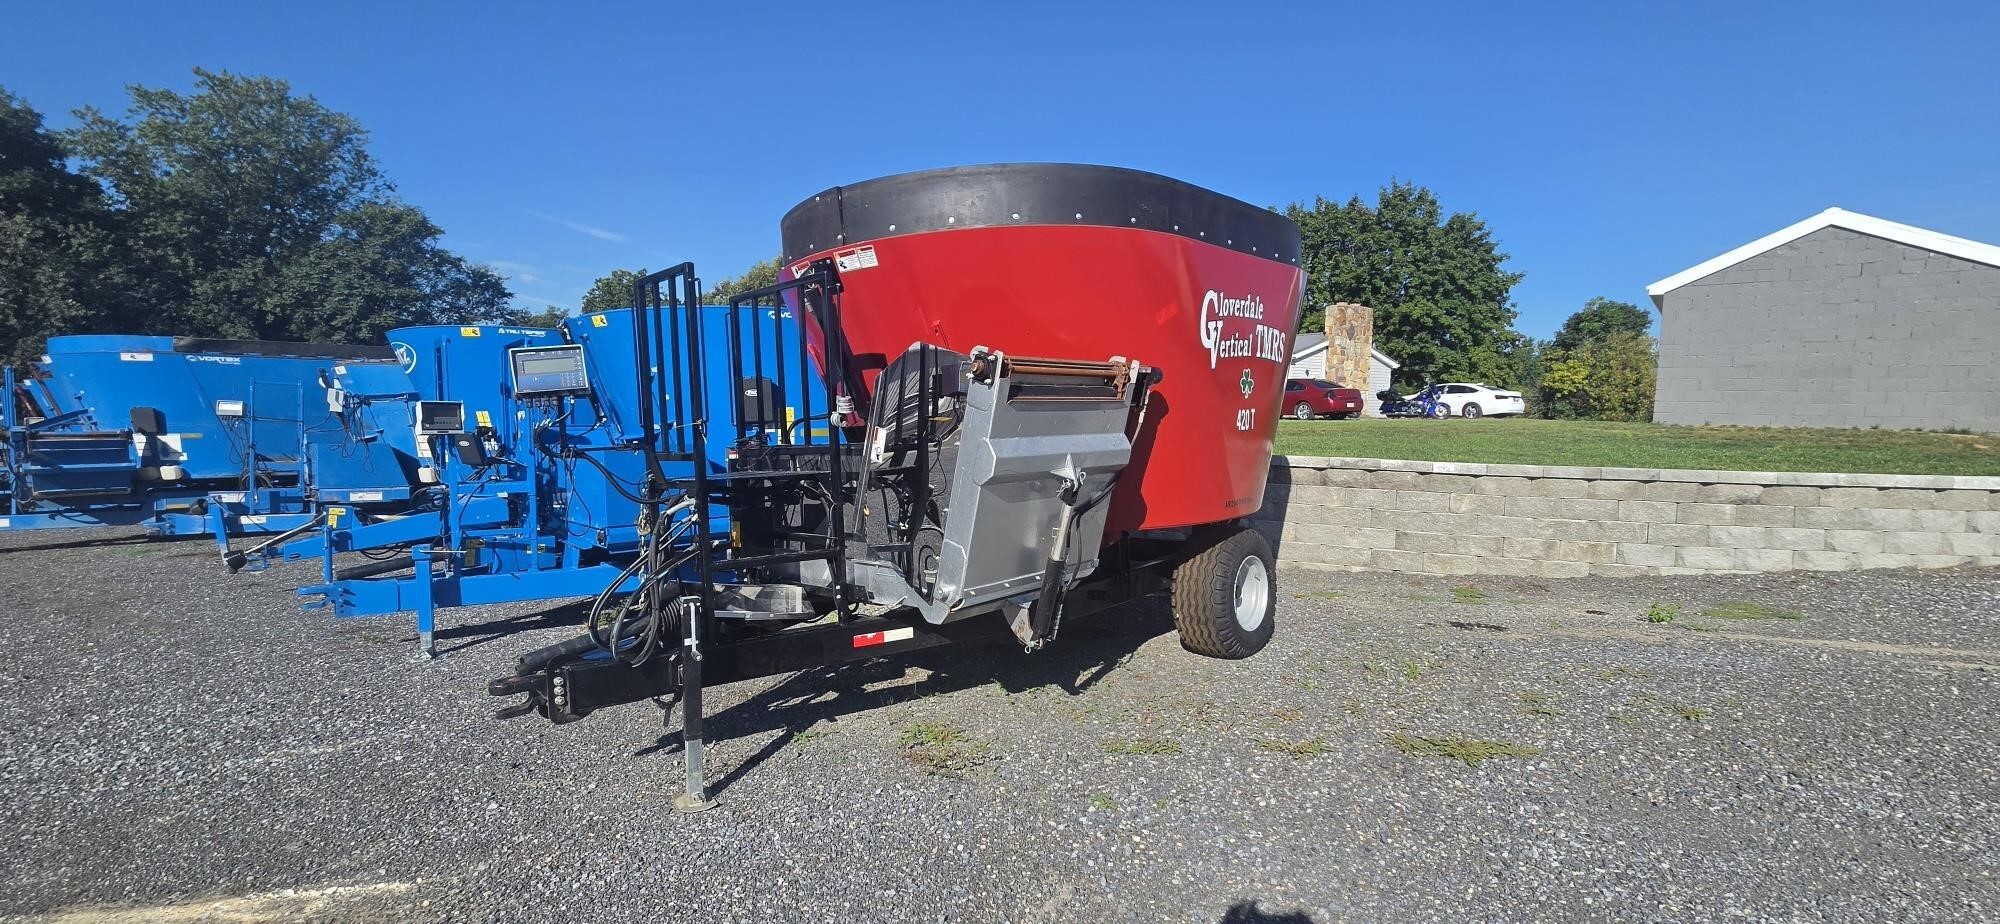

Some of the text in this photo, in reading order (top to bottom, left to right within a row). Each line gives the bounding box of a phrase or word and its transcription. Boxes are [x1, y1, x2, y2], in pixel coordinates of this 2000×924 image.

[1200, 289, 1264, 349] Cloverdale
[1207, 320, 1286, 369] Vertical TMRS
[1236, 408, 1256, 431] 420 T
